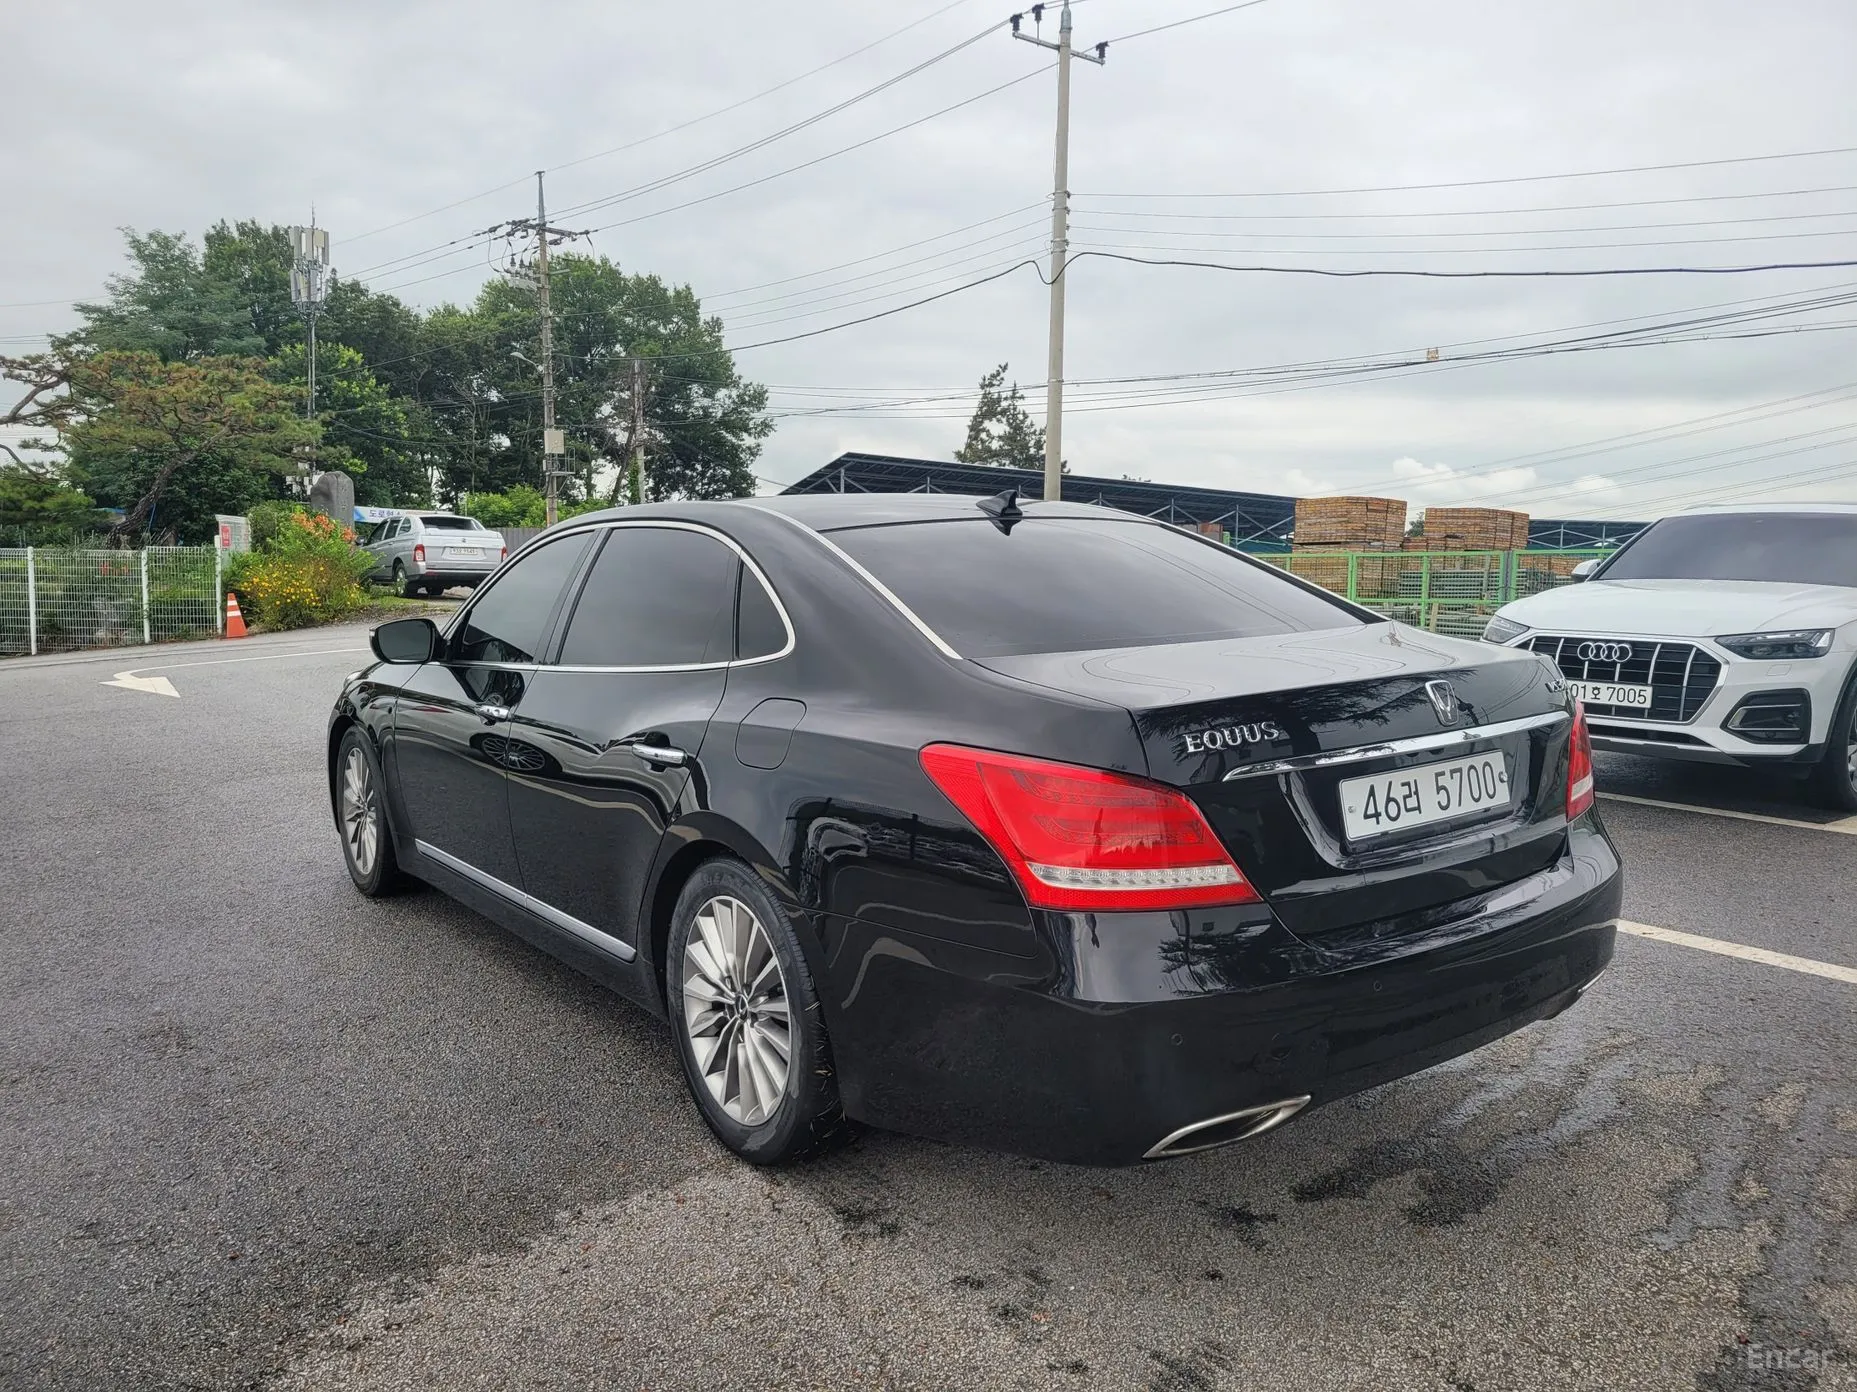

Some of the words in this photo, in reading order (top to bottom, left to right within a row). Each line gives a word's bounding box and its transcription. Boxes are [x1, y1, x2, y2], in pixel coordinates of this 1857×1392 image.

[1606, 686, 1648, 705] 7005
[1183, 721, 1280, 753] EQUUS
[1362, 778, 1422, 826] 46러
[1434, 760, 1497, 811] 5700
